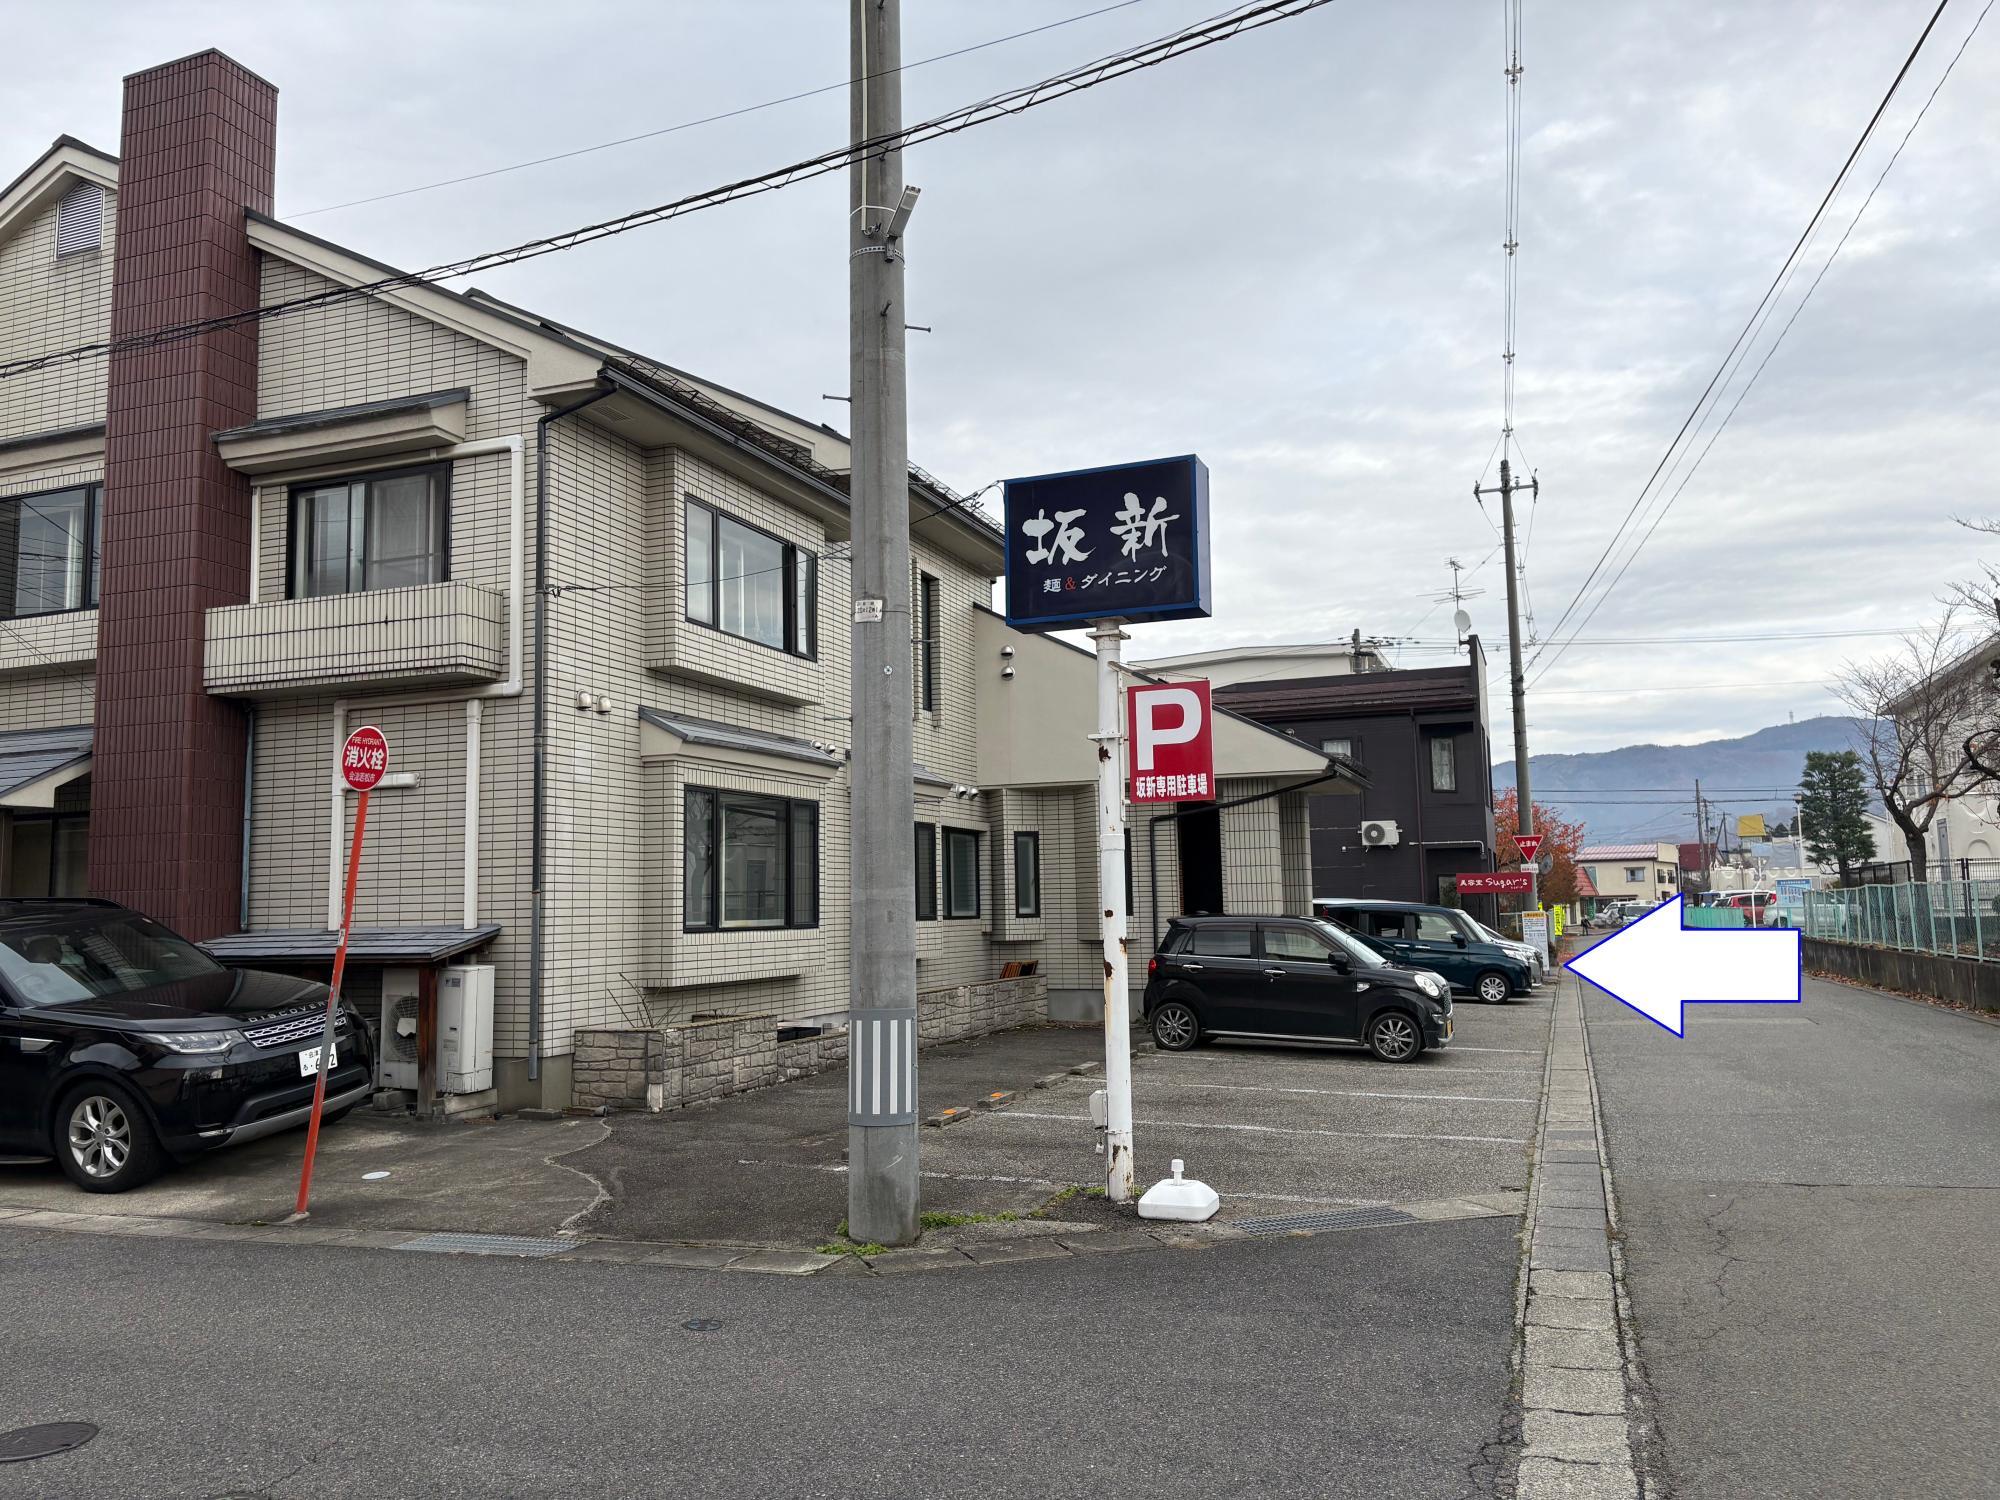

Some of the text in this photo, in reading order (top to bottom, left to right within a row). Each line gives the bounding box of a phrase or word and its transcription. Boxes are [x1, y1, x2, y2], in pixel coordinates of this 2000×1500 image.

[1022, 492, 1180, 565] 坂新
[1135, 688, 1202, 771] P
[345, 745, 385, 770] 消火栓
[1136, 773, 1208, 798] 坂新専用駐車場
[1485, 877, 1528, 889] Sugar's
[248, 1000, 328, 1023] DISCOVER
